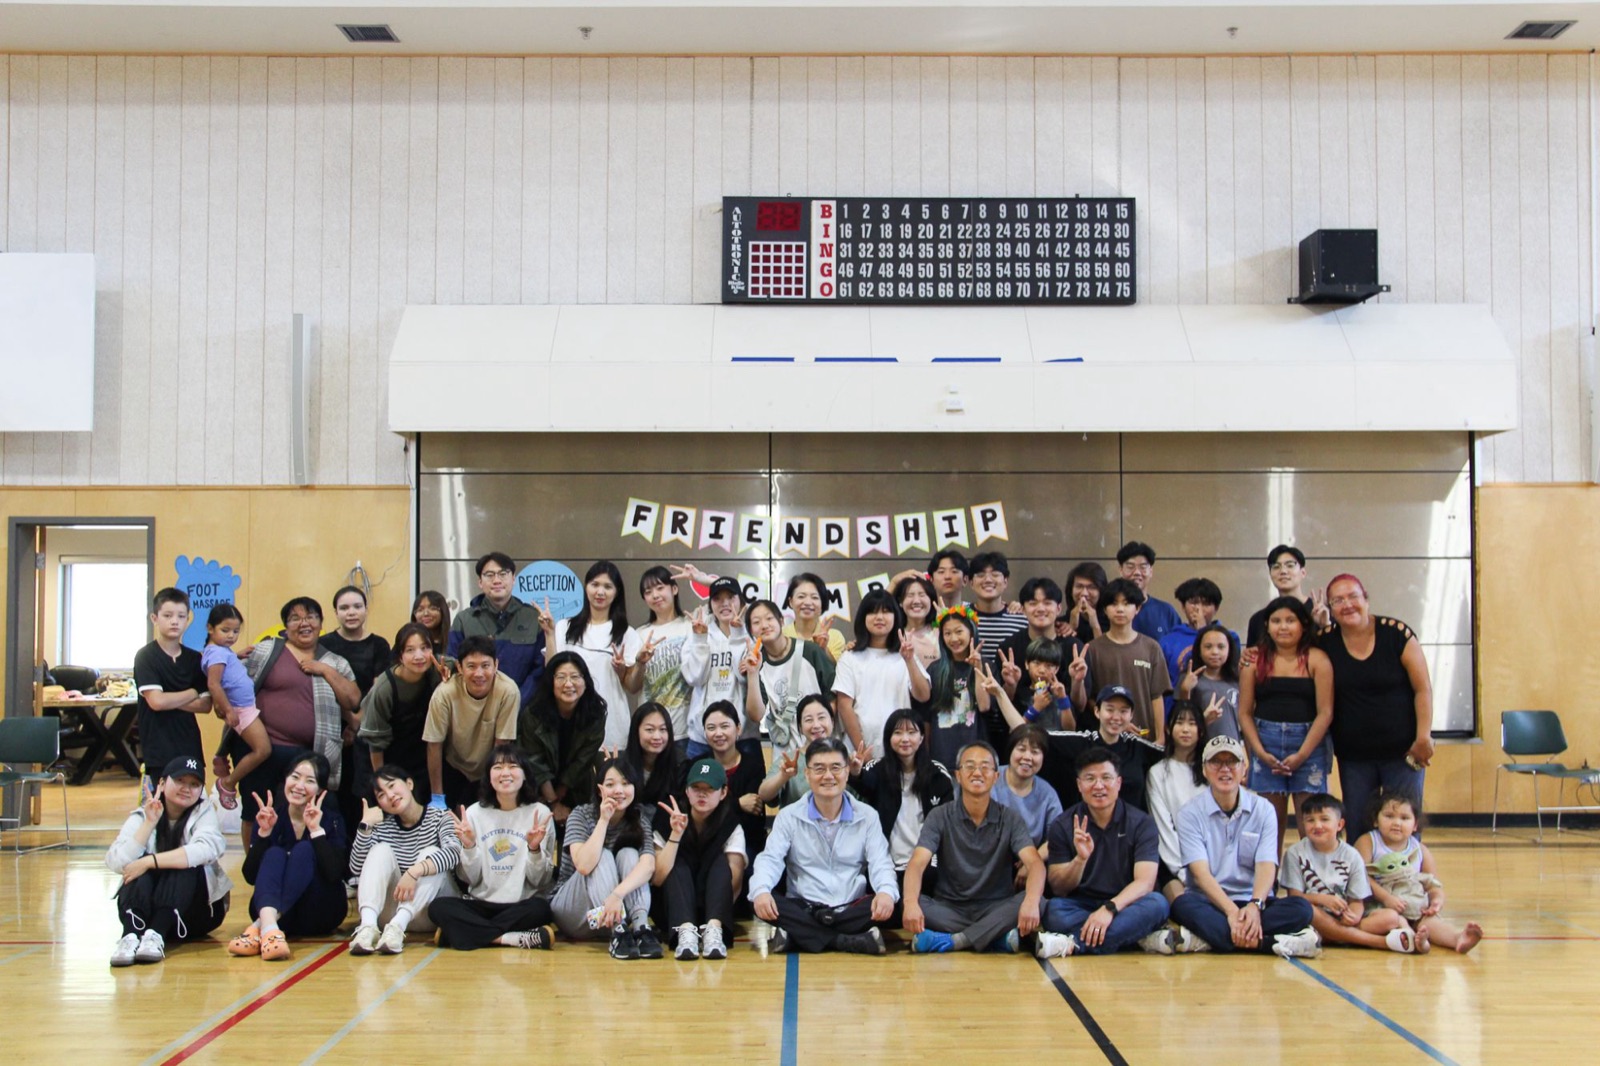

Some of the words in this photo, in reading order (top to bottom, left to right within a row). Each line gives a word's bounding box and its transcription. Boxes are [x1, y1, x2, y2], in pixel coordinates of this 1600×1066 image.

[843, 204, 848, 219] 1
[862, 204, 871, 219] 2
[881, 204, 890, 219] 3
[900, 204, 911, 219] 4
[921, 204, 930, 219] 5
[941, 204, 950, 219] 6
[961, 204, 969, 219] 7
[978, 204, 987, 219] 8
[998, 204, 1007, 219] 9
[1015, 204, 1028, 219] 10
[1037, 204, 1047, 219] 11
[1055, 204, 1068, 219] 12
[1075, 204, 1088, 219] 13
[1095, 204, 1108, 219] 14
[1115, 204, 1128, 219] 15
[840, 223, 852, 238] 16
[861, 223, 872, 238] 17
[880, 223, 892, 238] 18
[900, 224, 912, 239] 19
[918, 224, 933, 239] 20
[940, 224, 951, 238] 21
[958, 224, 972, 239] 22
[976, 223, 990, 238] 23
[996, 223, 1010, 238] 24
[1015, 223, 1030, 238] 25
[1035, 223, 1050, 238] 26
[1056, 223, 1069, 238] 27
[1075, 223, 1090, 238] 28
[1094, 223, 1109, 238] 29
[1114, 223, 1129, 238] 30
[731, 206, 742, 280] AUTOTRONIC
[819, 204, 834, 297] BINGO
[840, 243, 851, 258] 31
[859, 243, 873, 258] 32
[879, 243, 893, 258] 33
[899, 243, 913, 258] 34
[919, 243, 933, 258] 35
[938, 243, 953, 258] 36
[959, 243, 973, 258] 37
[976, 243, 991, 258] 38
[996, 243, 1011, 257] 39
[1015, 243, 1030, 257] 40
[1037, 243, 1049, 257] 41
[1055, 242, 1070, 257] 42
[1075, 242, 1090, 257] 43
[1095, 243, 1110, 257] 44
[1115, 243, 1130, 257] 45
[838, 263, 853, 278] 46
[859, 263, 873, 277] 47
[878, 263, 893, 278] 48
[898, 263, 913, 278] 49
[918, 263, 933, 278] 50
[940, 263, 951, 278] 51
[958, 263, 973, 278] 52
[976, 263, 991, 278] 53
[996, 263, 1011, 278] 54
[1015, 263, 1030, 278] 55
[1036, 263, 1050, 278] 56
[1056, 263, 1069, 278] 57
[1075, 263, 1090, 278] 58
[1095, 262, 1110, 278] 59
[1115, 262, 1130, 278] 60
[840, 282, 851, 297] 61
[859, 282, 874, 297] 62
[879, 282, 893, 297] 63
[898, 282, 913, 297] 64
[918, 282, 933, 297] 65
[938, 282, 953, 297] 66
[959, 283, 973, 297] 67
[976, 282, 991, 297] 68
[996, 282, 1011, 297] 69
[1016, 282, 1030, 297] 70
[1038, 282, 1049, 297] 71
[1056, 282, 1070, 297] 72
[1076, 282, 1090, 297] 73
[1096, 282, 1110, 297] 74
[1116, 282, 1130, 297] 75
[631, 504, 998, 545] FRIENDSHIP
[187, 582, 221, 598] FOOT
[518, 574, 576, 593] RECEPTION
